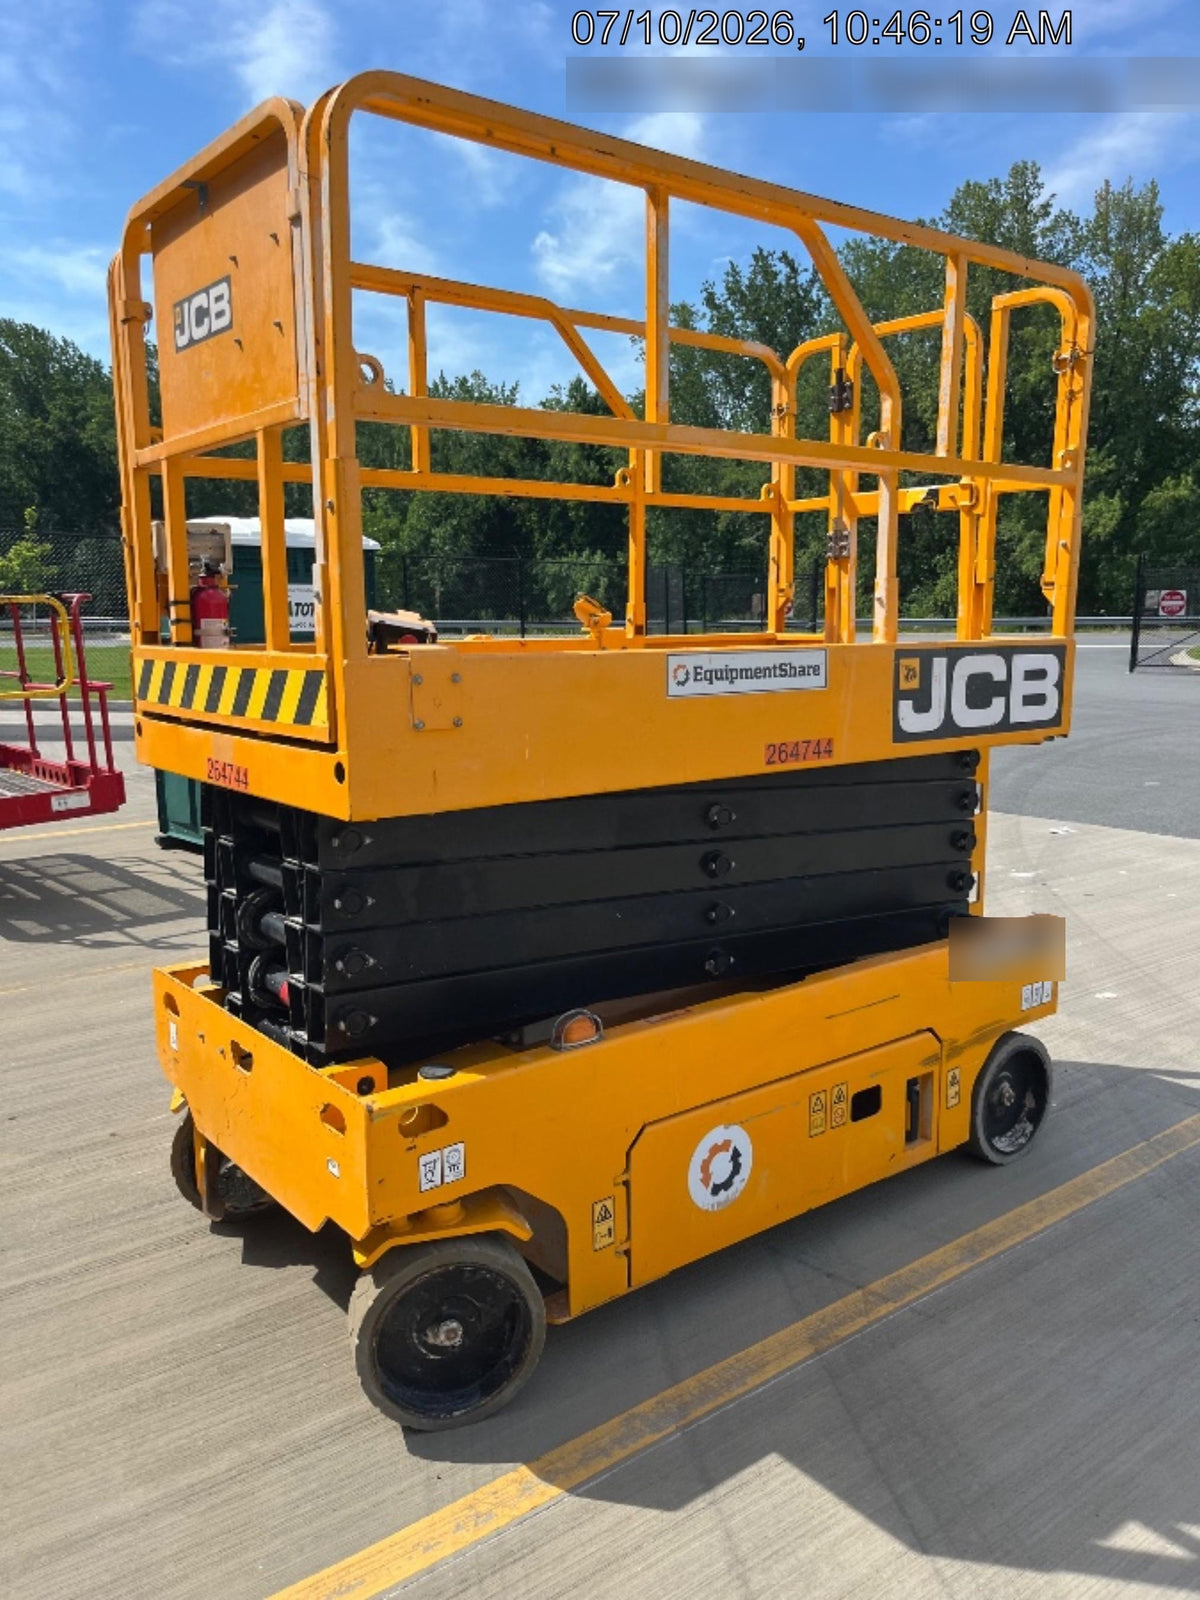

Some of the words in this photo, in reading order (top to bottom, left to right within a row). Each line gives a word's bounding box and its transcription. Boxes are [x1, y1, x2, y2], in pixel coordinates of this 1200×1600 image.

[175, 281, 231, 348] JCB
[692, 662, 821, 685] EquipmentShare
[898, 653, 1060, 734] JCB
[765, 738, 833, 765] 264744
[207, 757, 249, 790] 264744
